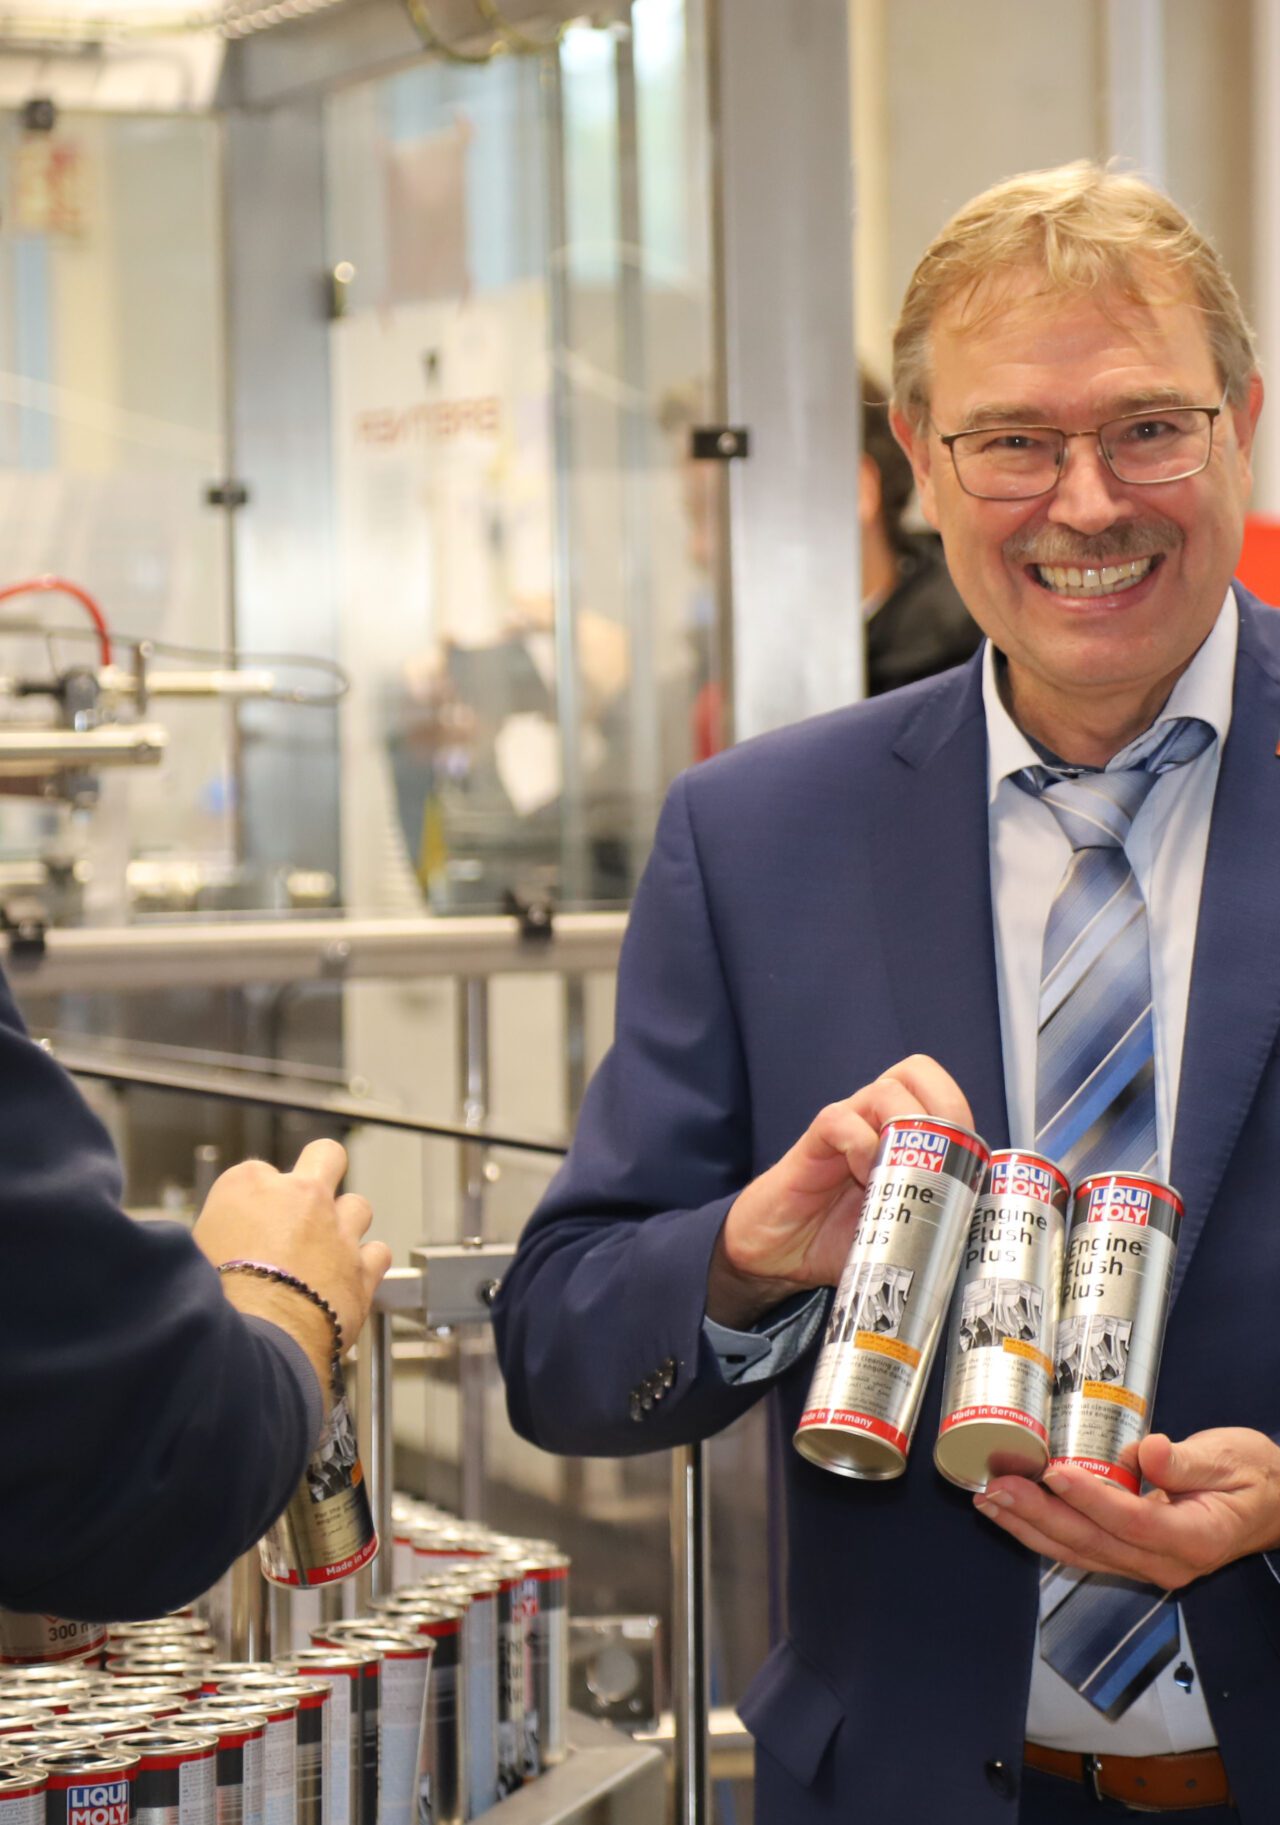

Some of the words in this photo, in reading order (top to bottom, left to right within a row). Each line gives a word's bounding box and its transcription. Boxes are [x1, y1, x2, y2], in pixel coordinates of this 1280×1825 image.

[893, 1131, 947, 1154] LIQUI
[887, 1149, 943, 1172] MOLY
[995, 1164, 1049, 1187] LIQUI
[994, 1180, 1048, 1200] MOLY
[1092, 1188, 1148, 1208] LIQUI
[970, 1207, 1048, 1231] Engine
[1090, 1205, 1147, 1223] MOLY
[967, 1227, 1033, 1249] Flush
[1068, 1232, 1143, 1258] Engine
[966, 1247, 1017, 1269] Plus
[1064, 1256, 1123, 1280] Flush
[1061, 1282, 1105, 1306] Plus
[817, 1409, 825, 1419] in
[829, 1410, 873, 1429] ermany
[951, 1408, 976, 1422] Made
[978, 1406, 988, 1415] in
[990, 1406, 1034, 1426] Germany
[326, 1561, 353, 1576] Made
[354, 1553, 363, 1564] in
[48, 1623, 77, 1641] 300
[71, 1783, 127, 1808] LIQUI
[71, 1804, 128, 1825] MOLY
